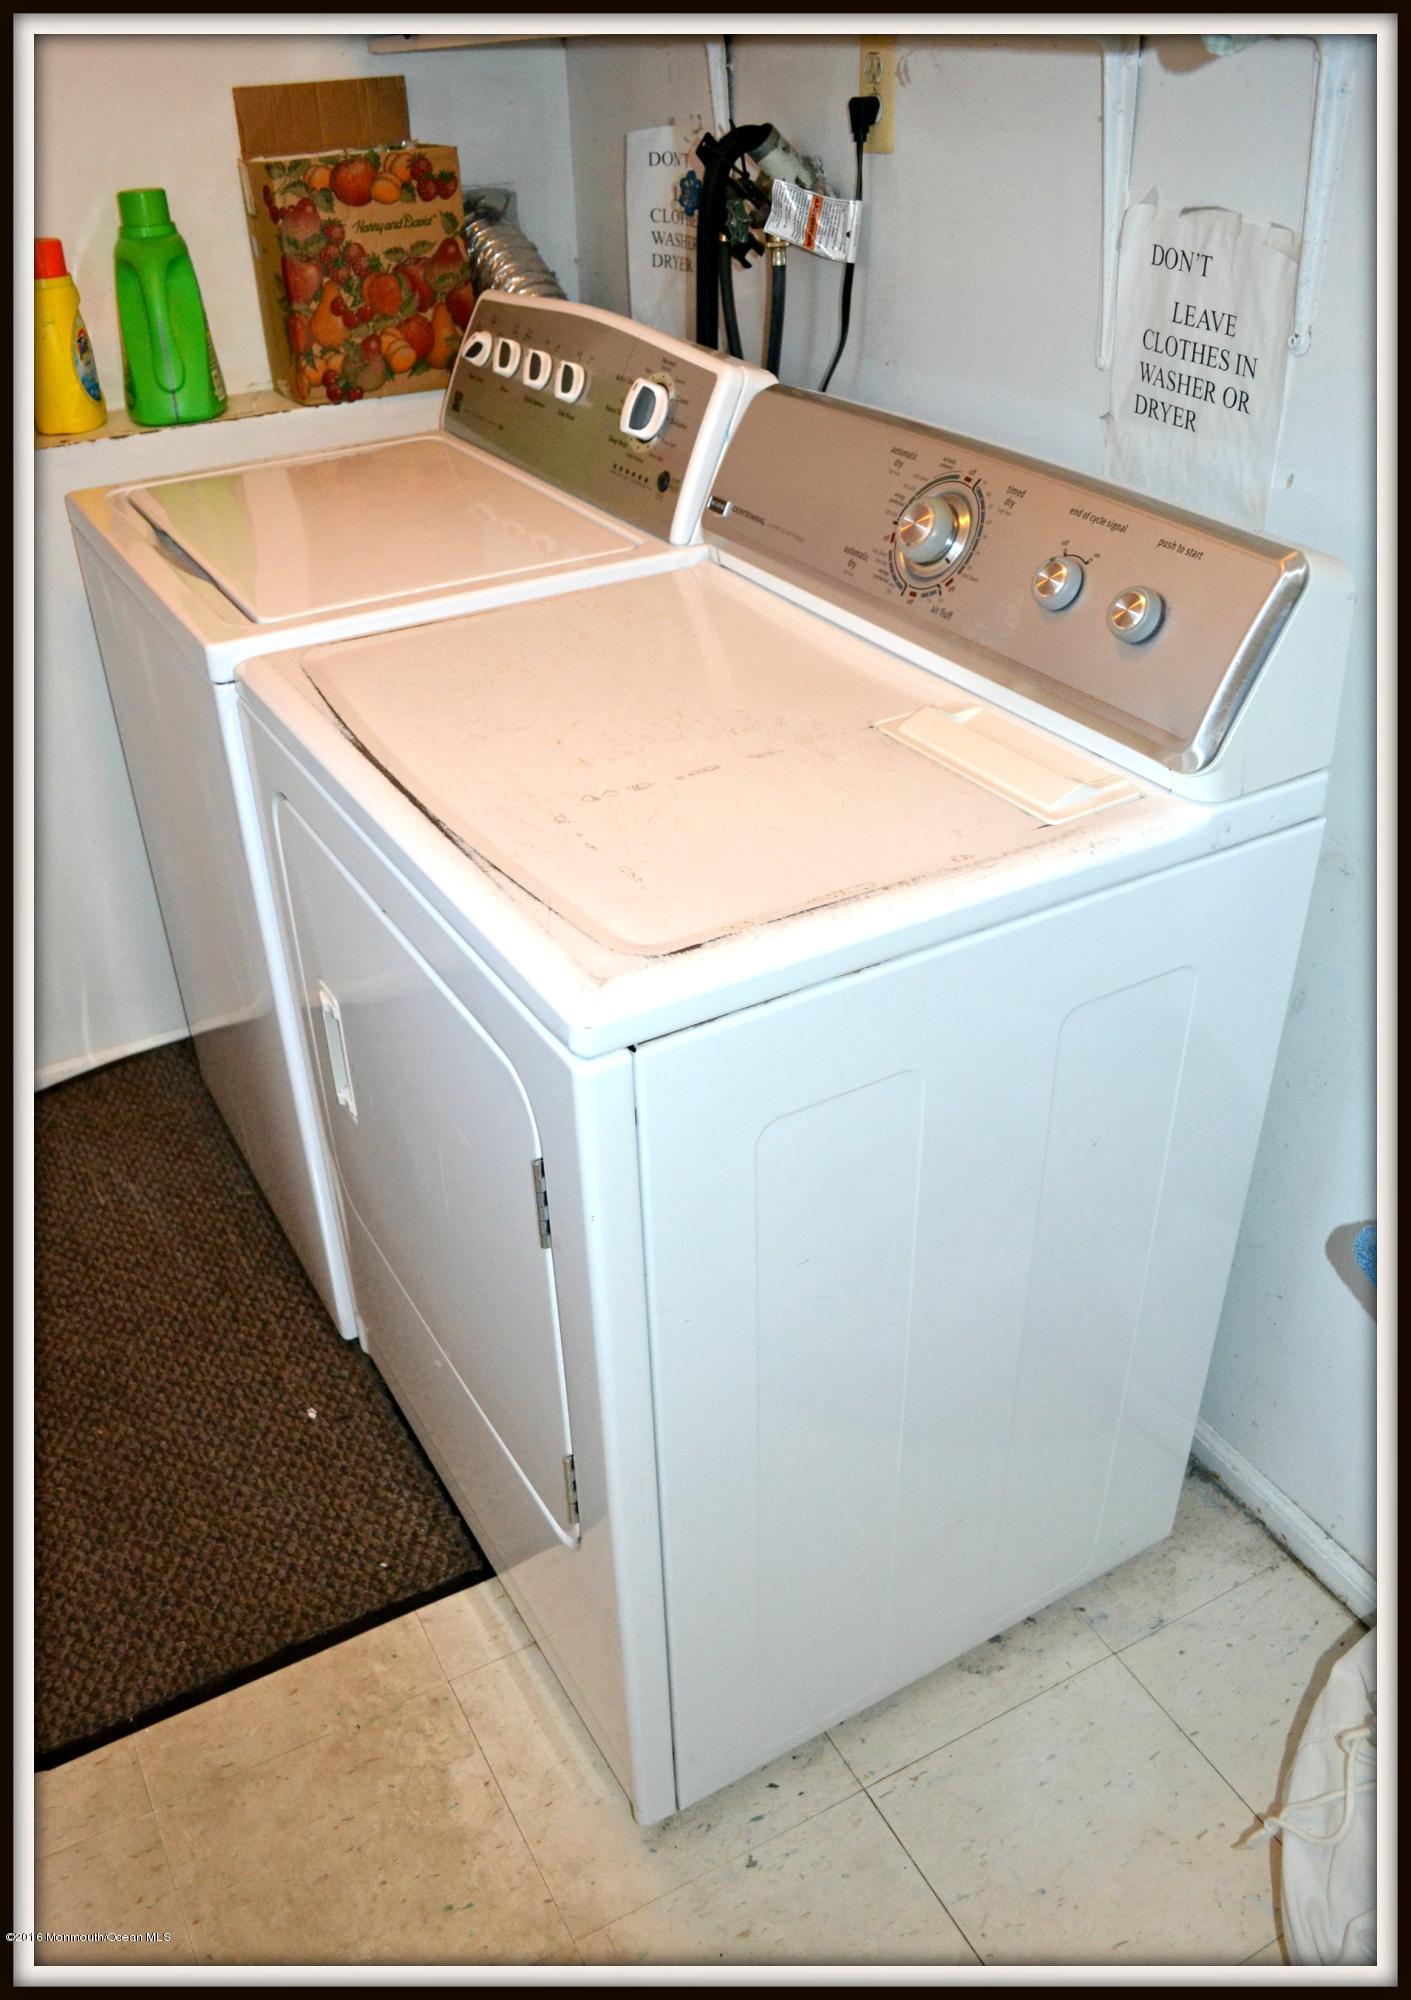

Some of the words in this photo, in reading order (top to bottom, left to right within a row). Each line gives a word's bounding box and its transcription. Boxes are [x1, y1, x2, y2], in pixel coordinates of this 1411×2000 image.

[651, 252, 694, 273] DRYER
[1151, 244, 1213, 277] DON'T
[1172, 301, 1238, 337] LEAVE
[1142, 328, 1230, 372] CLOTHES
[1235, 353, 1258, 379] IN
[1140, 361, 1216, 404] WASHER
[1222, 386, 1250, 415] OR
[1134, 393, 1197, 432] DRYER
[1006, 485, 1027, 498] timed
[1069, 507, 1083, 518] end
[1089, 514, 1107, 527] cycle
[1107, 519, 1129, 534] signal
[1157, 537, 1177, 551] push
[1177, 543, 1186, 553] to
[1185, 547, 1204, 560] start
